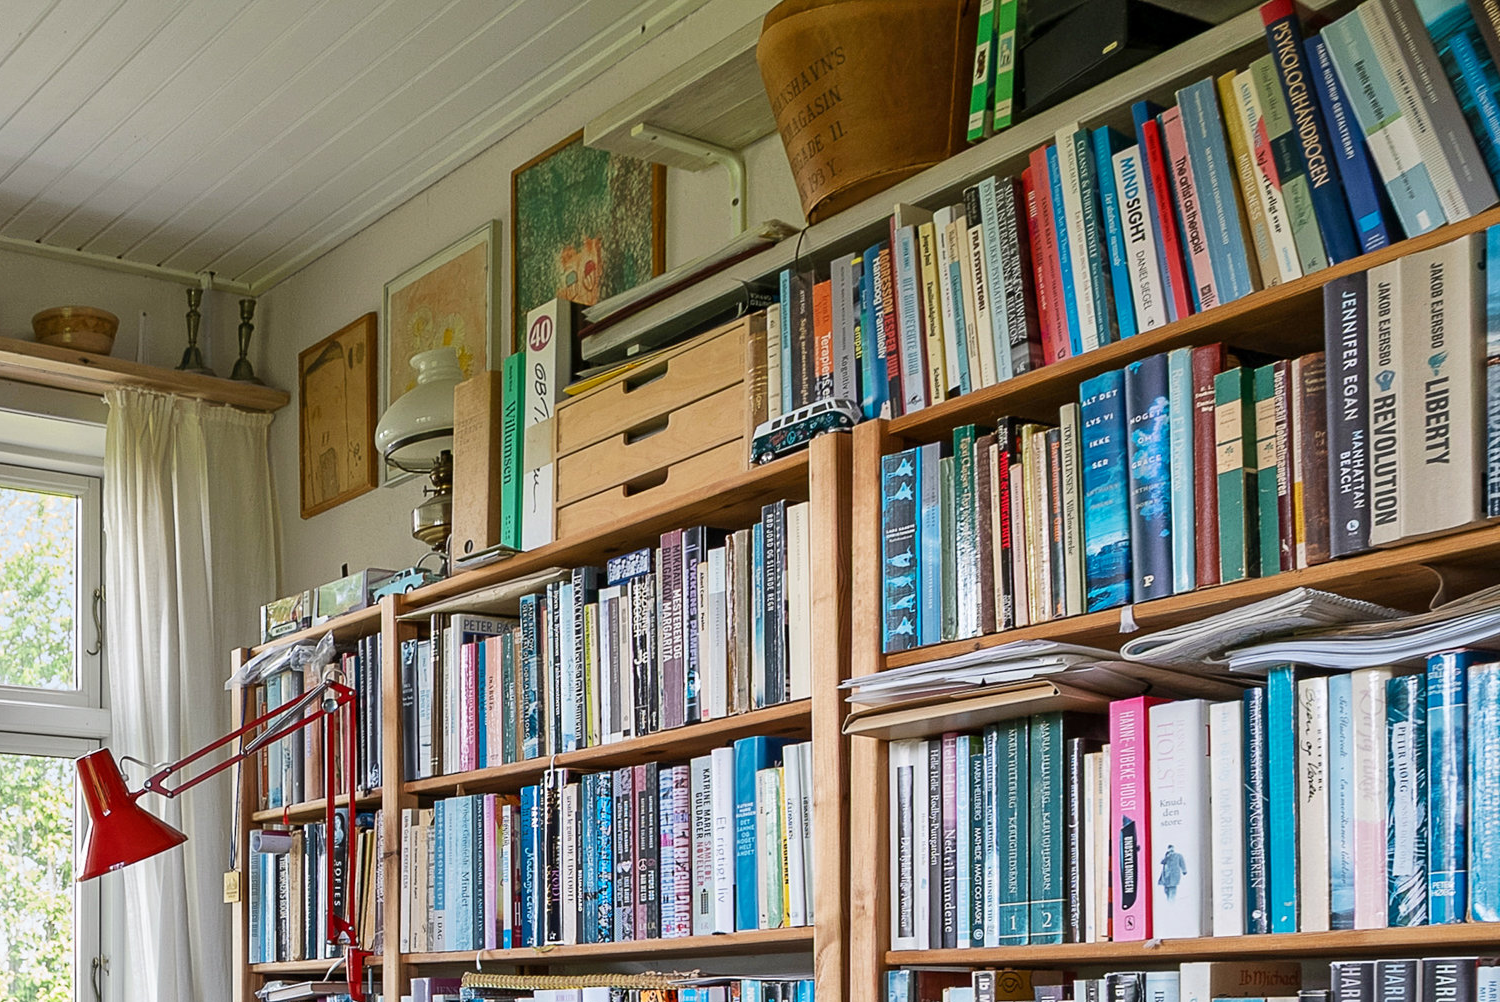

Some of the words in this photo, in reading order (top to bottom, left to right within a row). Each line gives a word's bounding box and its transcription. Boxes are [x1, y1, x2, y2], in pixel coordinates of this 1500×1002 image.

[1272, 21, 1330, 189] PSYKOLOGIHÅNDBOGEN
[1120, 157, 1146, 244] MINDSIGHT
[1178, 174, 1194, 202] artist
[1186, 212, 1206, 256] therapist
[878, 249, 894, 314] AGGRESSION
[1134, 250, 1149, 284] DANIEL
[1430, 262, 1444, 299] JAKOB
[1139, 283, 1153, 312] SIEGEL
[1378, 281, 1392, 320] JAKOB
[530, 319, 551, 347] 40
[883, 313, 896, 353] JESPER
[1341, 291, 1358, 371] JENNIFER
[1378, 320, 1392, 367] EJERSBO
[1430, 301, 1444, 349] EJERSBO
[886, 353, 900, 381] JUUL
[1081, 395, 1097, 408] ALT
[1098, 388, 1119, 400] DET
[1343, 374, 1358, 422] EGAN
[1063, 423, 1072, 447] TOVE
[1085, 418, 1103, 429] LYS
[1103, 412, 1114, 422] VI
[1425, 376, 1450, 466] LIBERTY
[503, 400, 516, 485] Willumsen
[1089, 435, 1111, 448] IKKE
[1373, 393, 1397, 527] REVOLUTION
[1065, 447, 1075, 496] DITLEVSEN
[1091, 457, 1109, 469] SER
[1340, 452, 1352, 495] BEACH
[1351, 429, 1365, 509] MANHATTAN
[662, 547, 672, 600] BULGAKOV
[672, 544, 682, 588] MIKHAIL
[662, 602, 674, 662] MARGARITA
[672, 588, 682, 640] MESTEREN
[673, 642, 682, 660] OG
[930, 749, 939, 771] Helle
[1119, 710, 1136, 782] HANNE-VIBEKE
[1398, 726, 1407, 757] PETER
[702, 768, 711, 805] KATRINE
[931, 771, 940, 792] Helle
[1120, 782, 1136, 811] HOLST
[695, 792, 703, 840] GULDAGER
[1159, 797, 1187, 807] Knud,
[1162, 808, 1180, 817] den
[703, 807, 711, 837] MARIE
[716, 817, 726, 833] Et
[1160, 817, 1183, 827] store
[715, 835, 726, 882] rigtigt
[944, 829, 956, 853] Ned
[944, 855, 954, 870] til
[1123, 835, 1133, 894] UNDSKYLDNINGEN
[717, 886, 726, 903] liv
[944, 871, 954, 934] hundene
[978, 977, 991, 989] Ib
[1114, 984, 1126, 997] IB
